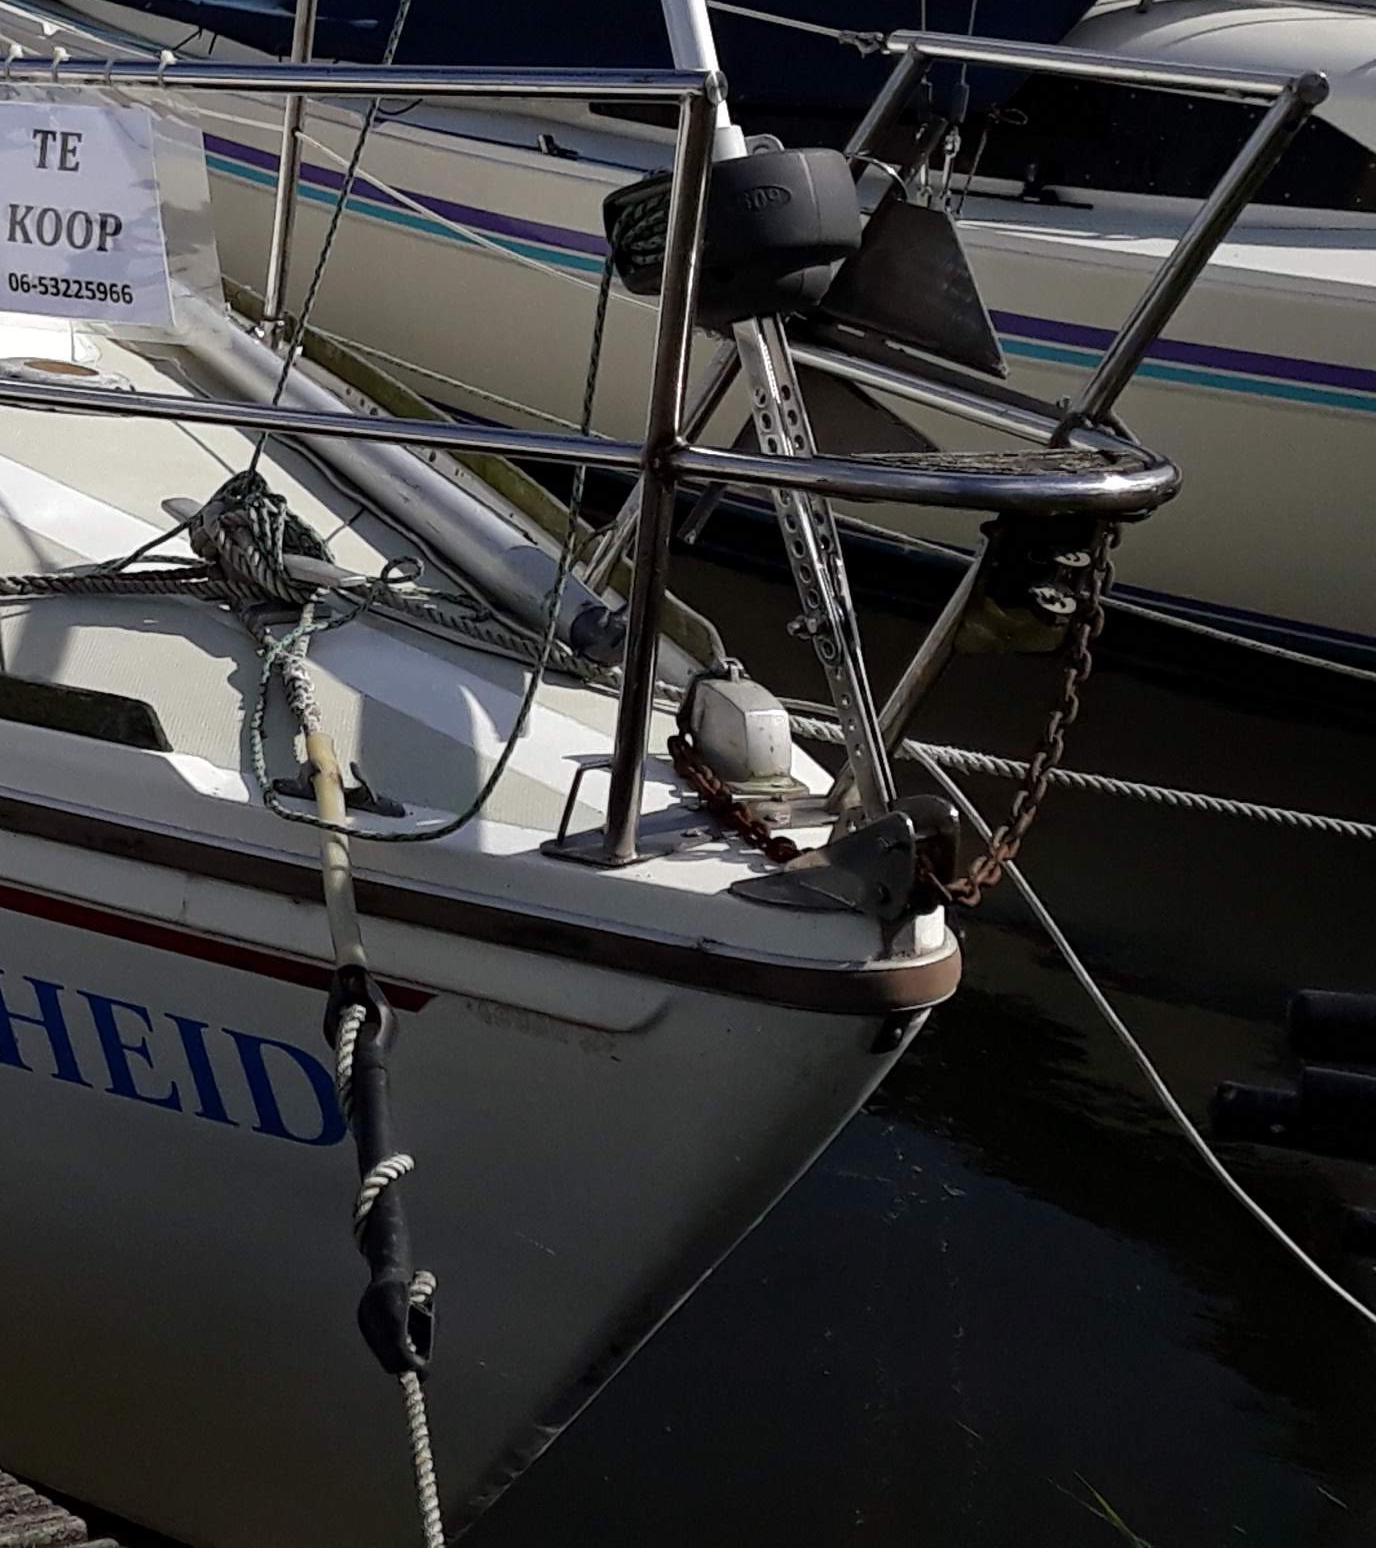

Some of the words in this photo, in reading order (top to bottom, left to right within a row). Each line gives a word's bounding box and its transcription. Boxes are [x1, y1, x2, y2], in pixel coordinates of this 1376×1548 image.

[32, 128, 83, 172] TE
[6, 203, 123, 252] KOOP
[7, 271, 134, 305] 06-53225966
